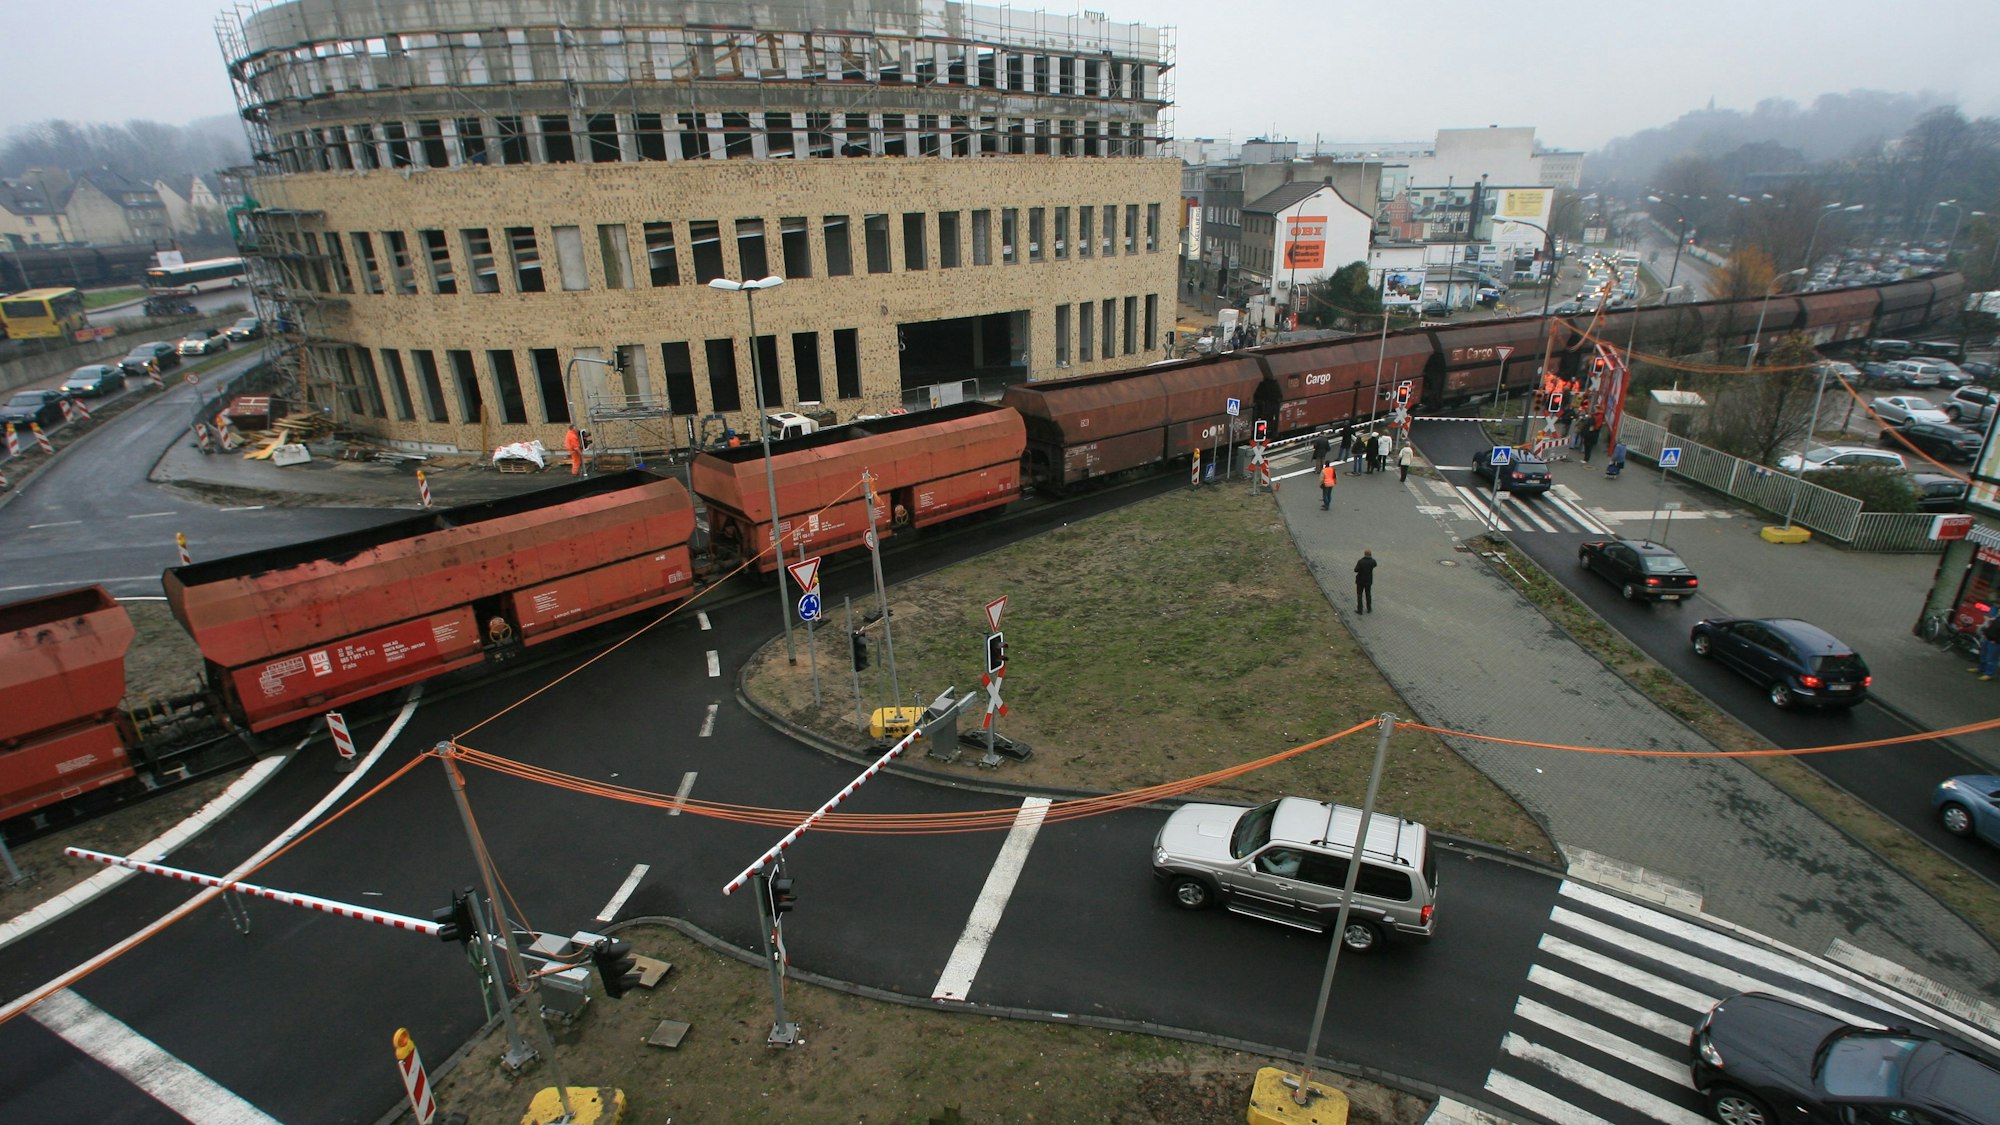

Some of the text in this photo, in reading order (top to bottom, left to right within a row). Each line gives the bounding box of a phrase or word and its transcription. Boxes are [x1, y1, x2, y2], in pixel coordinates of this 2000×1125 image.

[1291, 227, 1322, 236] OBI
[1466, 347, 1493, 359] Cargo
[1305, 372, 1331, 385] Cargo
[1943, 518, 1973, 527] KIOSK
[885, 725, 909, 734] M+V
